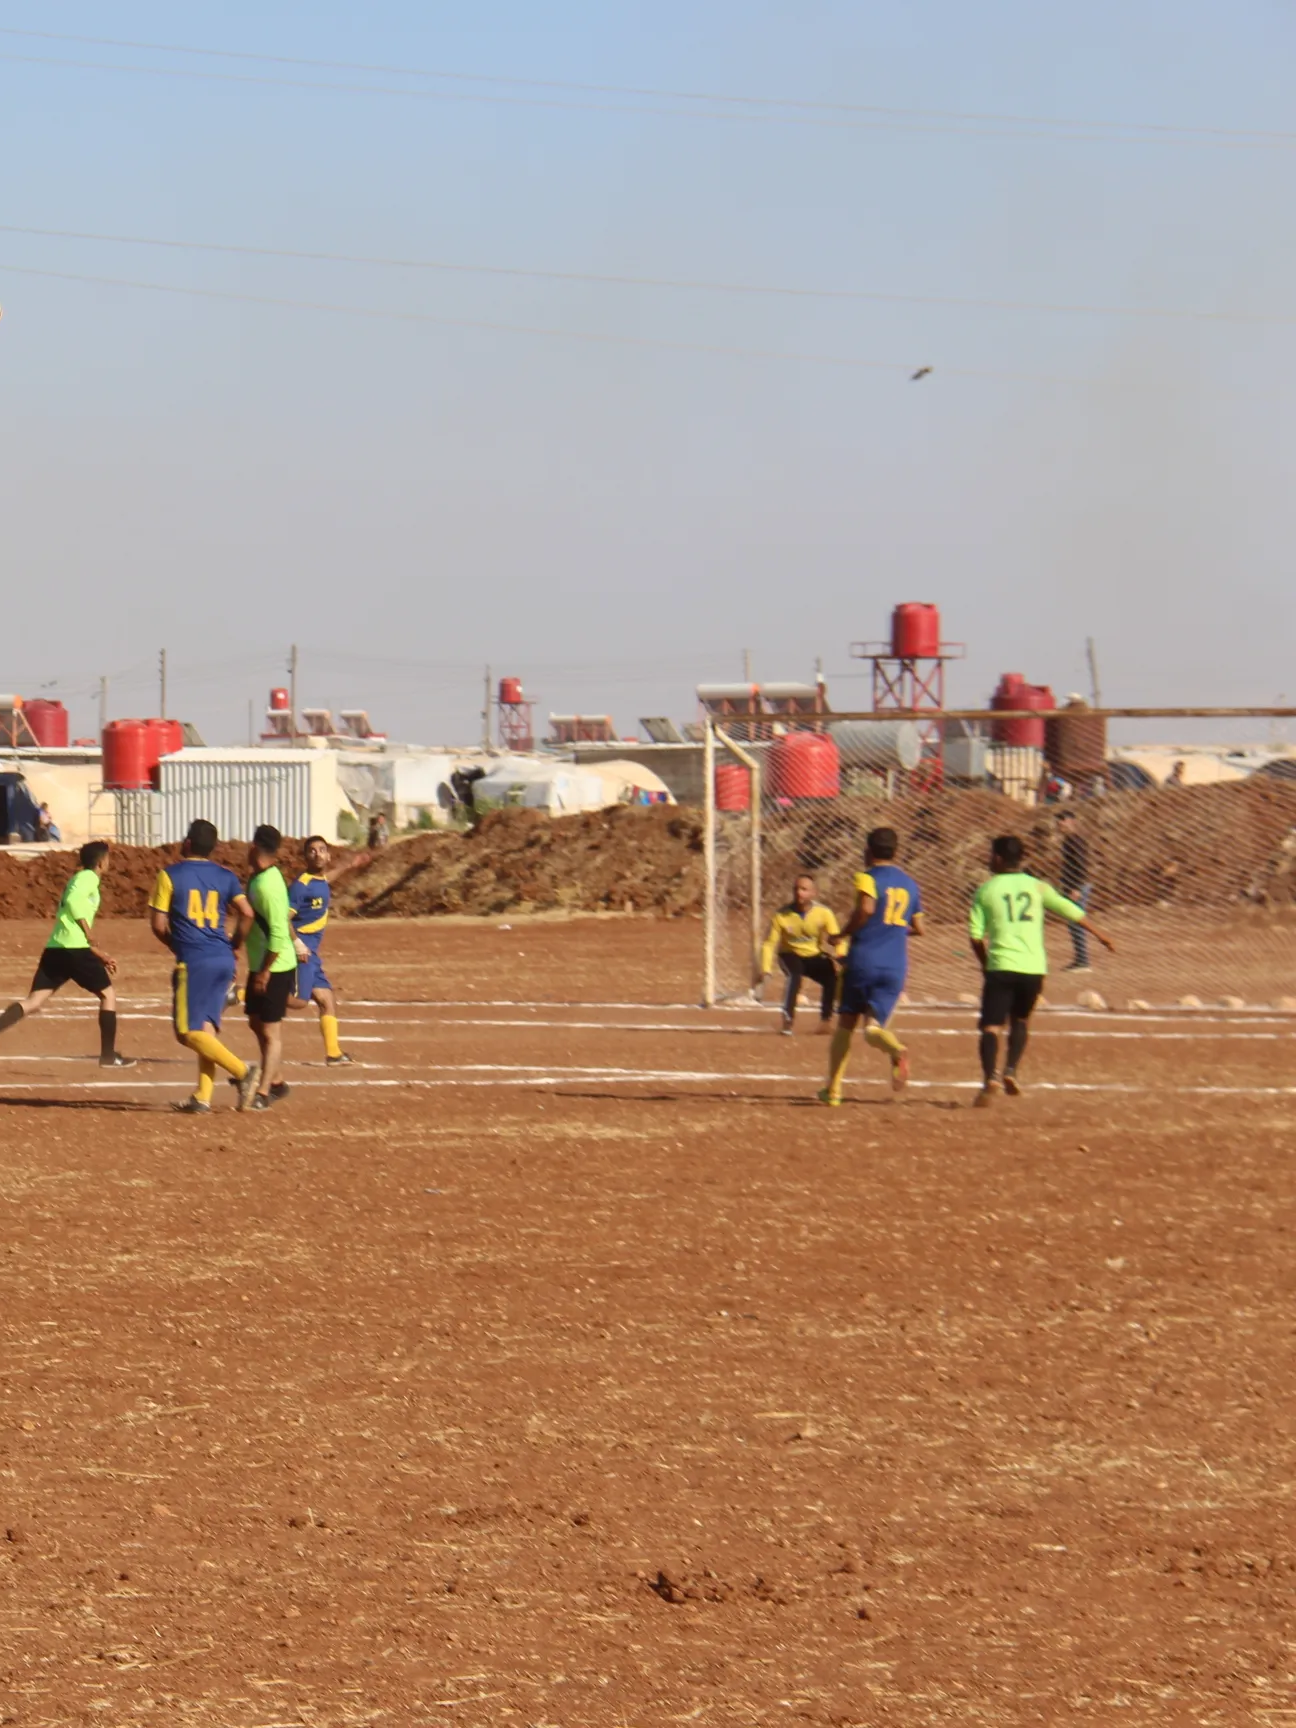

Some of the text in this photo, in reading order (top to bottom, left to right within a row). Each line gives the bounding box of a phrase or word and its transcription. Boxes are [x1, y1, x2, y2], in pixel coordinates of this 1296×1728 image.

[187, 888, 220, 929] 44
[883, 887, 910, 927] 12
[1001, 891, 1033, 922] 12
